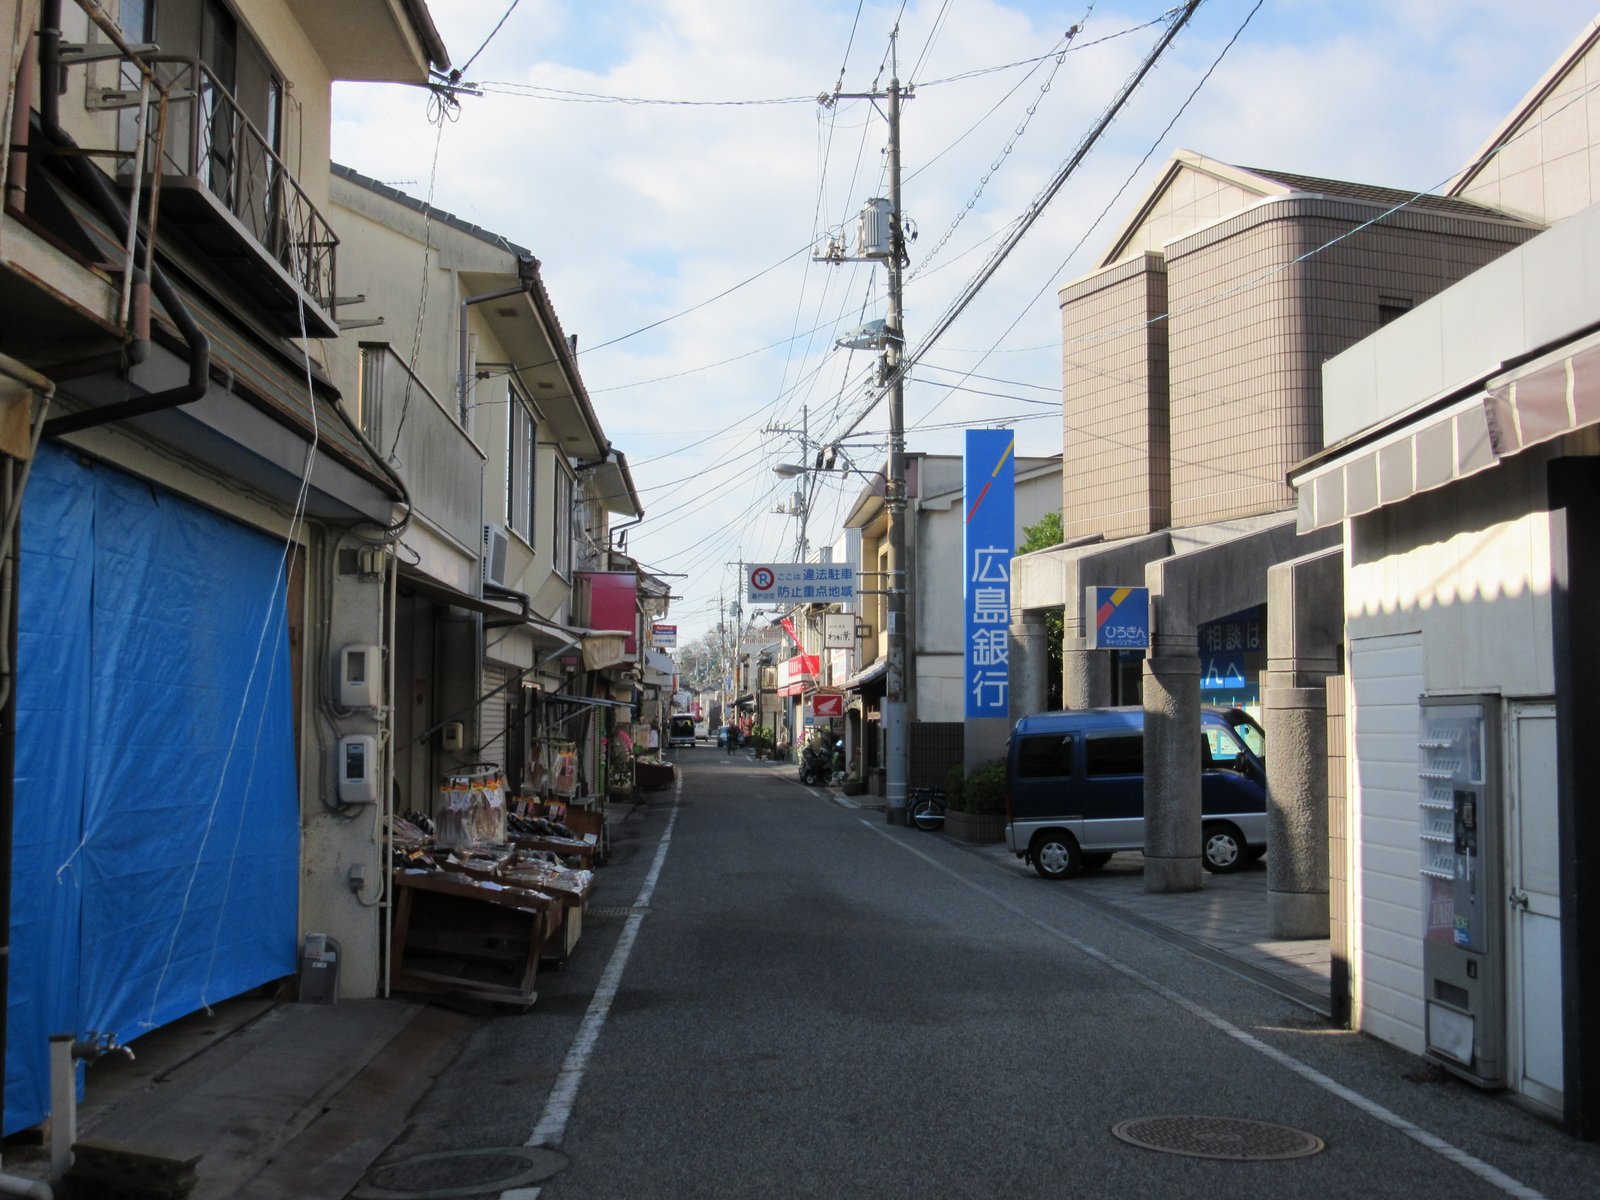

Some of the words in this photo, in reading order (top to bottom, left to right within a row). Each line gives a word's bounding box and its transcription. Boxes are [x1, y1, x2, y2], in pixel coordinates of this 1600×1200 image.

[777, 585, 853, 598] 防止重点地域
[971, 545, 1009, 708] 広島銀行
